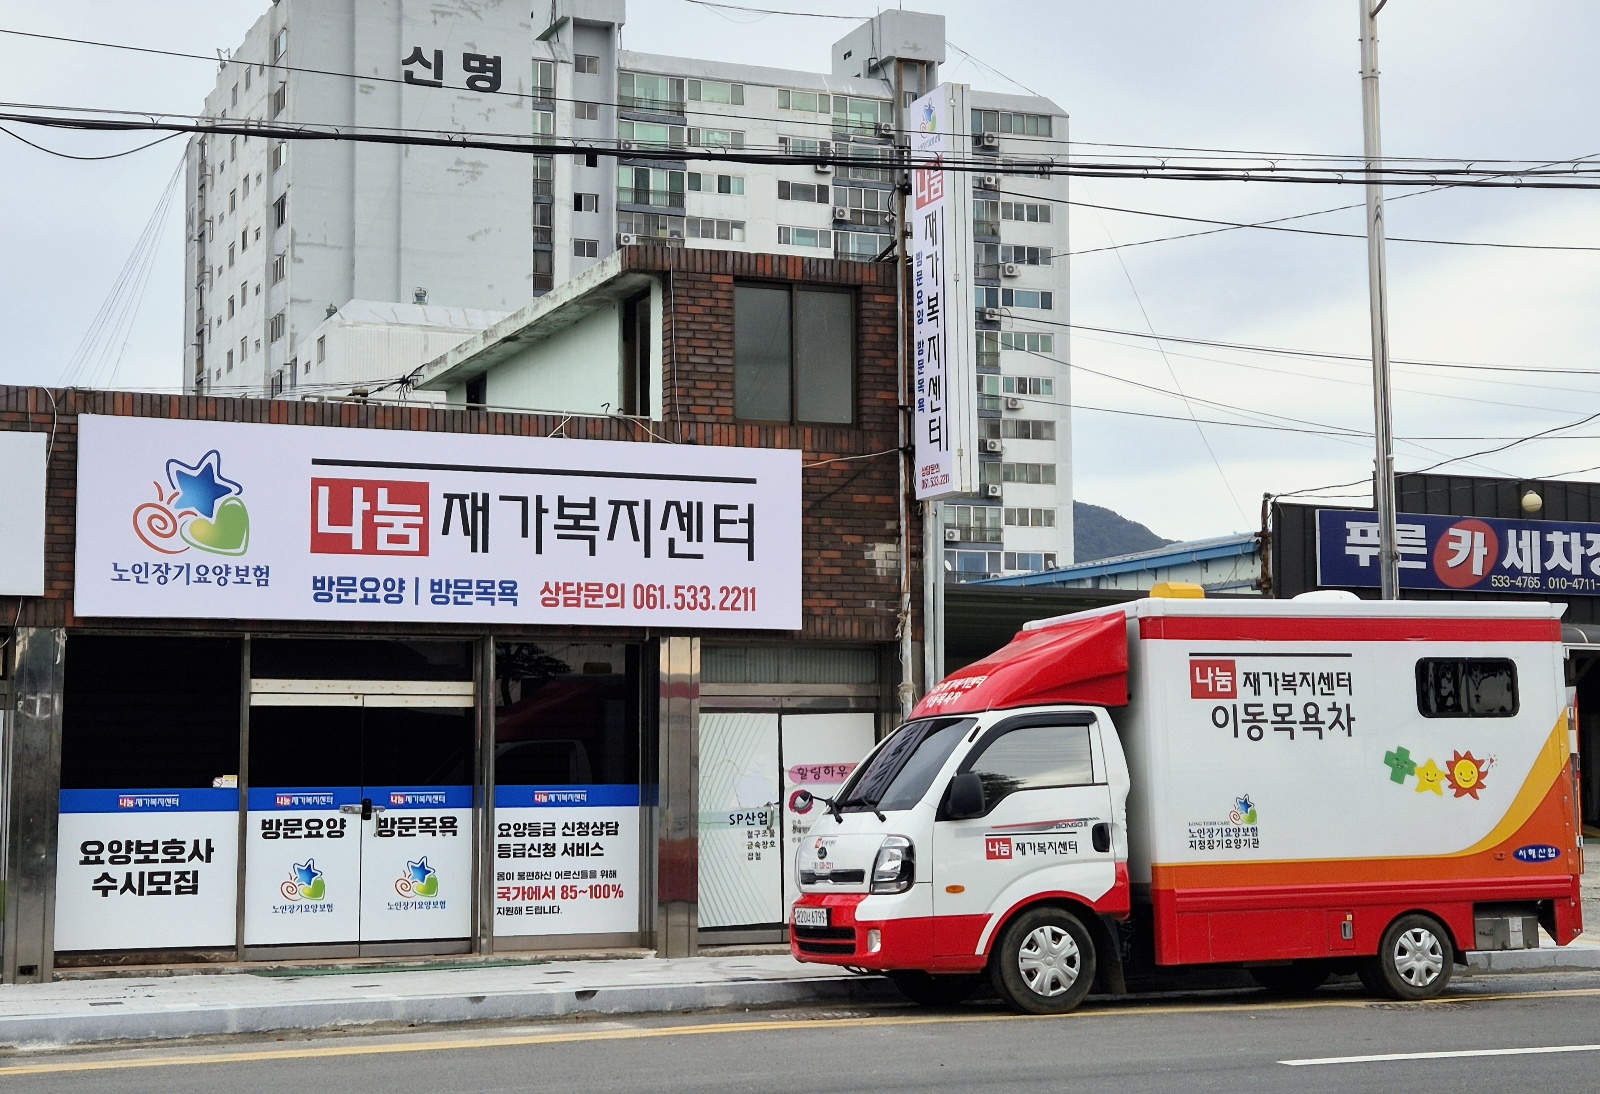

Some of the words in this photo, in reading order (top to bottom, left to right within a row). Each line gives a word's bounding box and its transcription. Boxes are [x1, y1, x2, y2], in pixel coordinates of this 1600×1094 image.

[402, 46, 501, 92] 신명
[316, 484, 424, 552] 나눔
[441, 491, 757, 561] 재가복지센터
[110, 561, 272, 588] 노인장기요양보험
[312, 575, 406, 605] 방문요양
[430, 578, 519, 607] 방문목욕
[540, 581, 626, 609] 상담문의
[632, 583, 757, 612] 061.533.2211
[1194, 666, 1233, 694] 나눔
[1242, 671, 1353, 697] 재가복지센터
[1211, 702, 1356, 742] 이동목욕차
[261, 817, 347, 840] 방문요양
[377, 815, 458, 838] 방문목욕
[728, 811, 768, 827] SP산업
[497, 822, 556, 838] 요양등급
[561, 821, 620, 837] 신청상담
[1188, 826, 1259, 838] 노인장기요양보험
[79, 838, 215, 866] 요양보호사
[497, 843, 557, 859] 등급신청
[561, 842, 604, 858] 서비스
[988, 841, 1011, 857] 나눔
[1015, 841, 1078, 856] 재가복지센터
[1188, 838, 1260, 850] 지정장기요양기관
[92, 869, 199, 897] 수시모집
[517, 870, 552, 881] 불편하신
[554, 870, 598, 880] 어르신들을
[600, 869, 618, 879] 위해
[496, 885, 556, 902] 국가에서
[560, 883, 625, 900] 85~100%
[272, 903, 334, 914] 노인장기요양보험
[387, 900, 447, 911] 노인장기요양보험
[496, 905, 523, 916] 지원해
